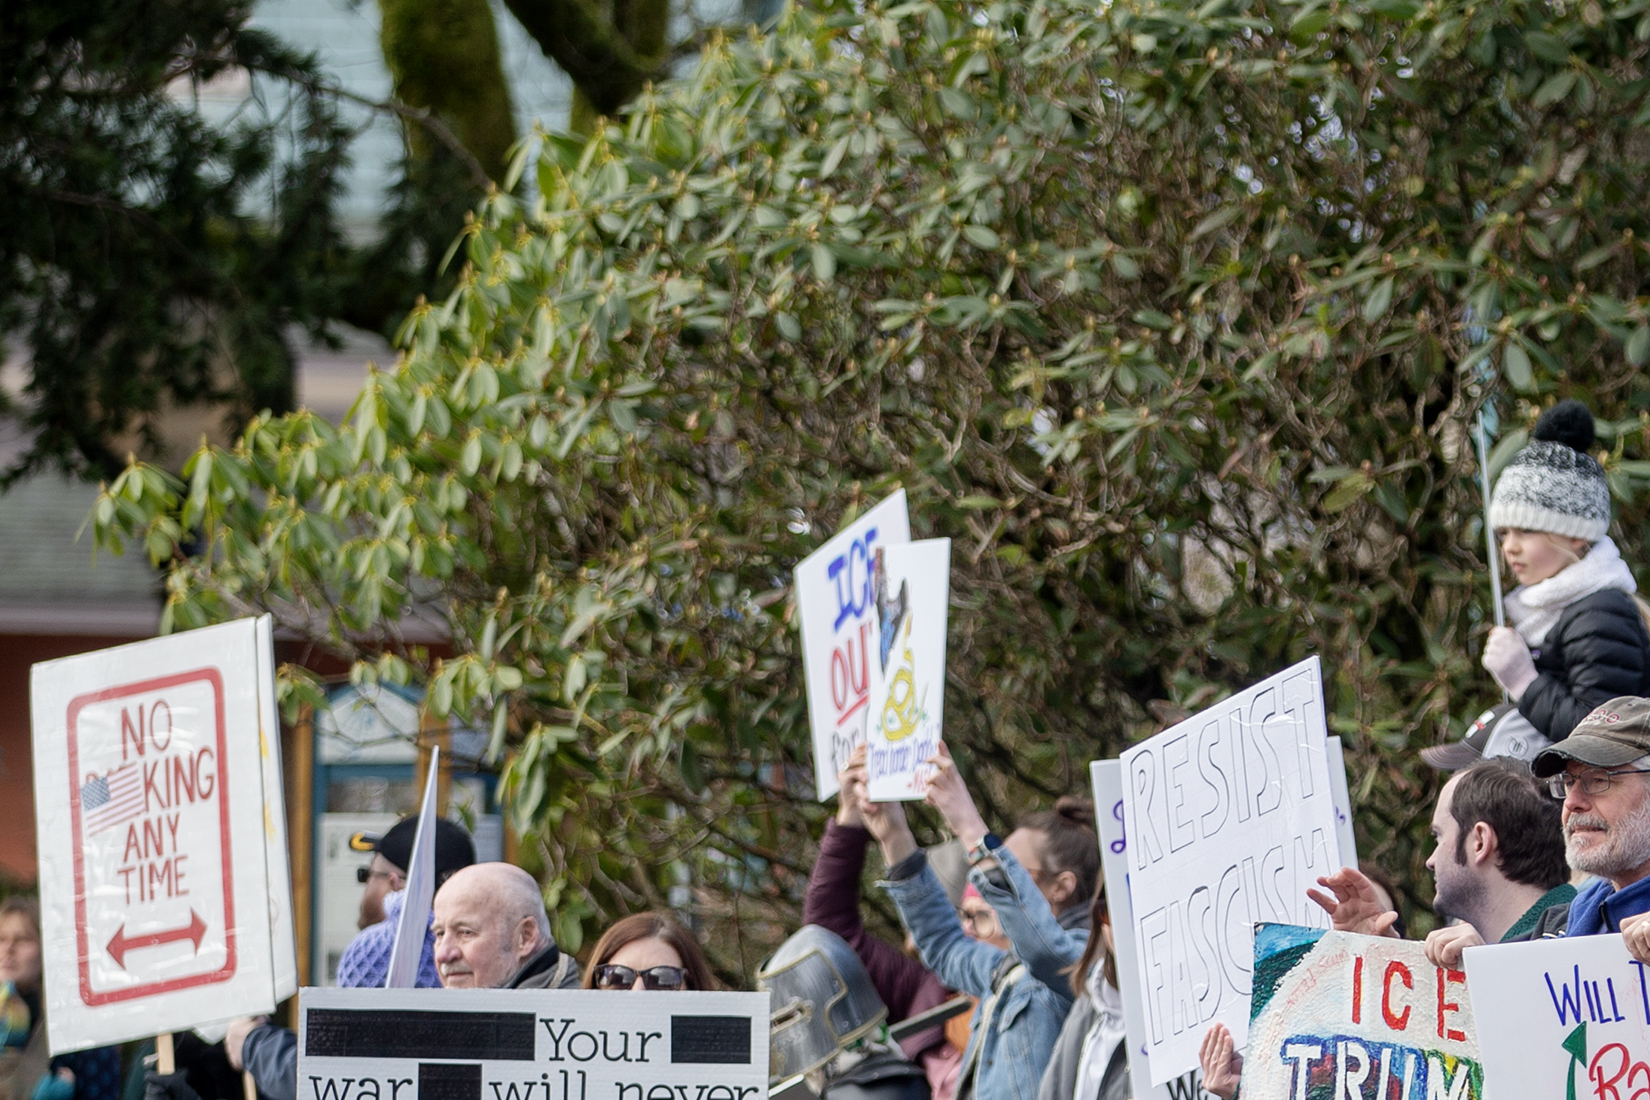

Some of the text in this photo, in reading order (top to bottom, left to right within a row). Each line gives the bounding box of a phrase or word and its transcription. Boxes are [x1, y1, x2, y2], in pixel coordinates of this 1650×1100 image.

[831, 621, 872, 711] OU
[121, 699, 172, 760] NO
[1130, 668, 1315, 870] RESIST
[124, 812, 181, 863] ANY
[117, 855, 190, 905] TIME
[1139, 828, 1334, 1046] FASCISM
[1352, 955, 1466, 1042] ICE
[1544, 964, 1625, 1026] WILL
[539, 1017, 662, 1063] Your
